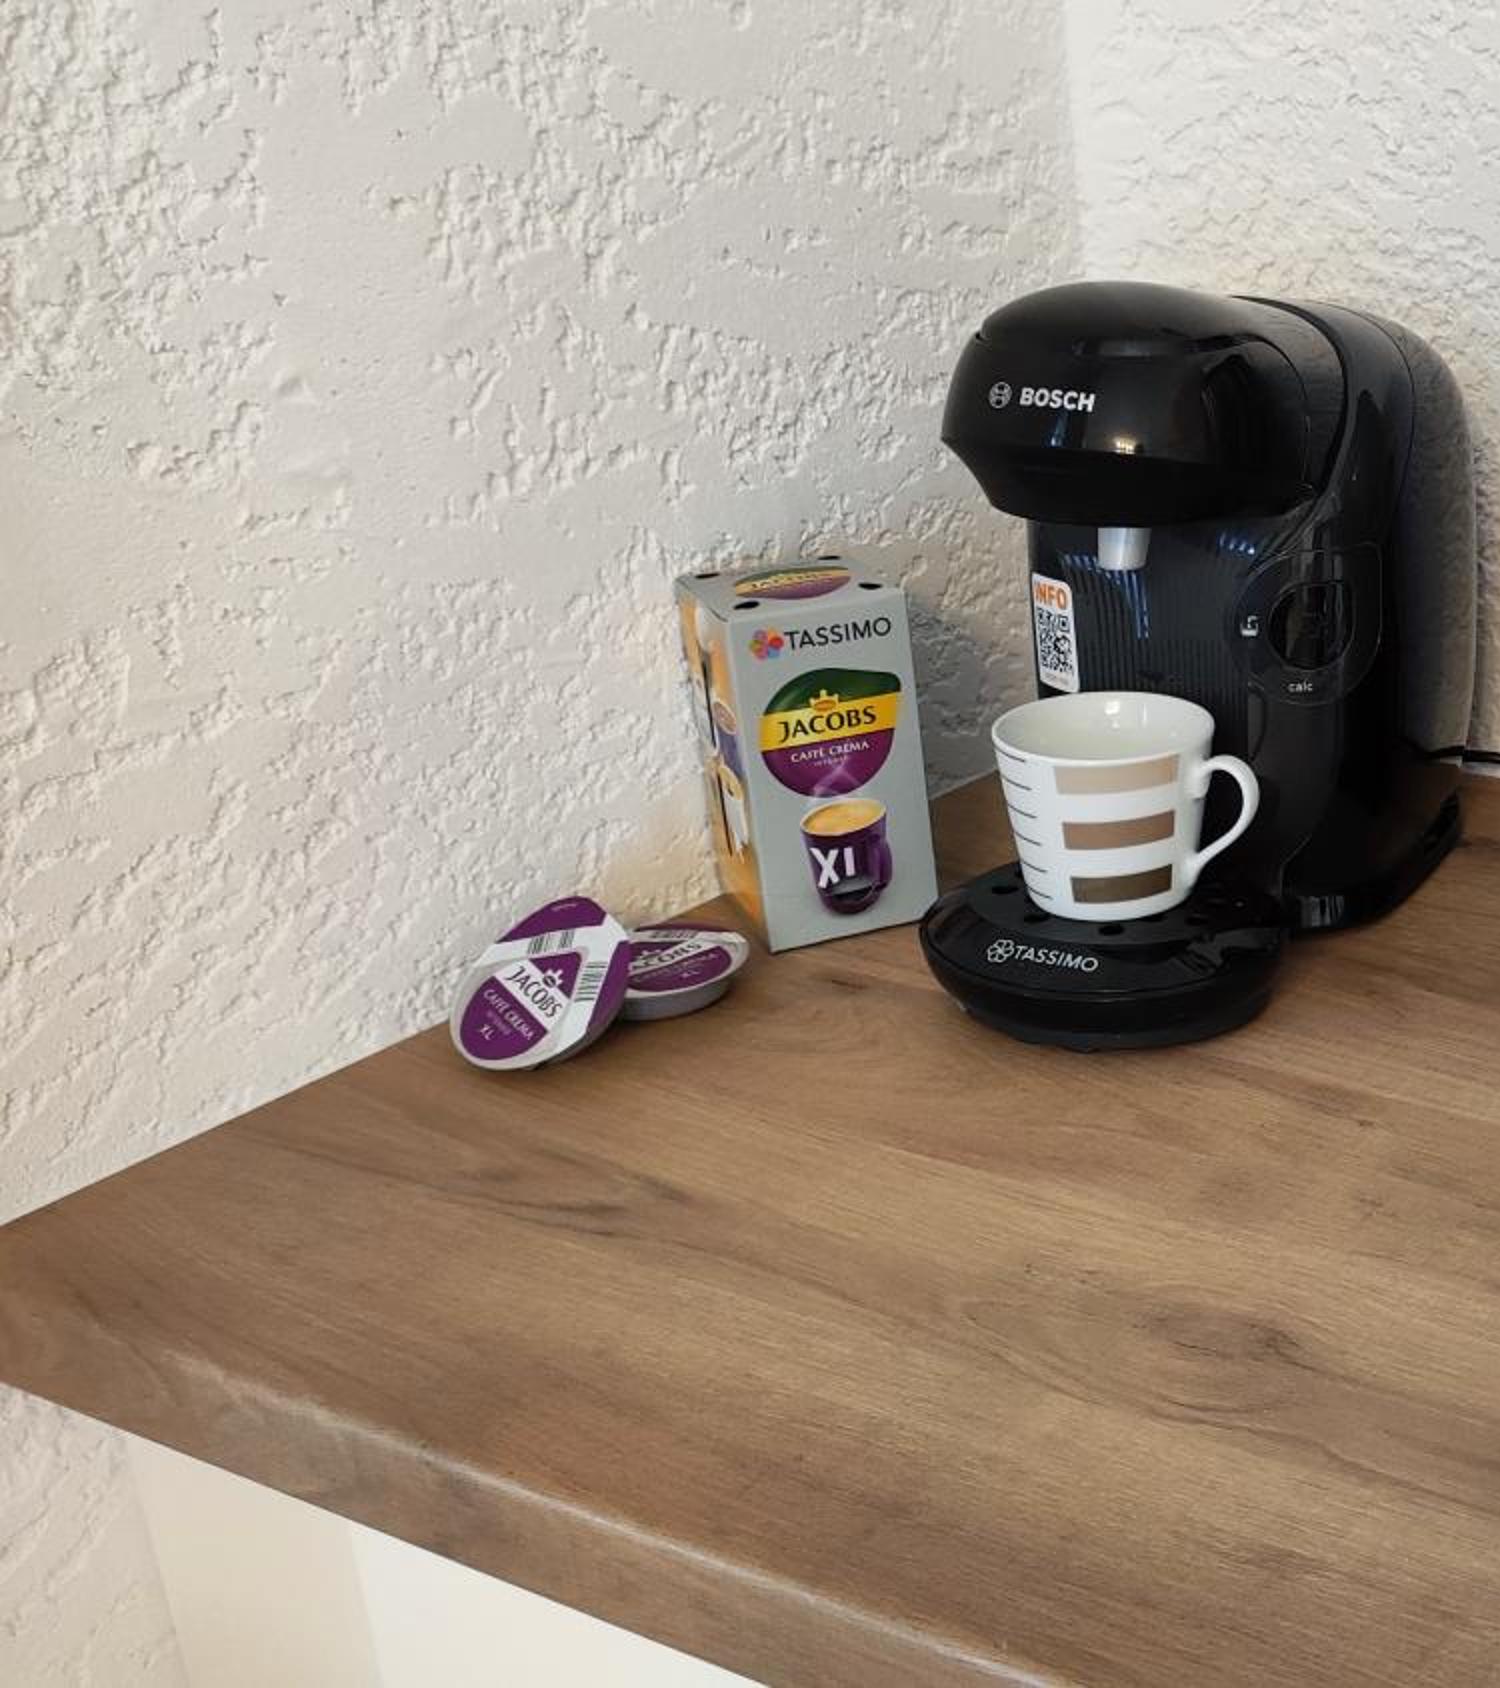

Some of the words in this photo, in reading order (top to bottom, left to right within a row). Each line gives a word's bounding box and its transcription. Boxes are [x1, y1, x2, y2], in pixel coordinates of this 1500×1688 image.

[1019, 386, 1096, 413] BOSCH
[784, 616, 892, 651] TASSIMO
[1286, 678, 1314, 693] calc
[778, 704, 877, 743] JACOBS
[1014, 944, 1099, 972] TASSIMO
[504, 965, 563, 1018] JACOBS
